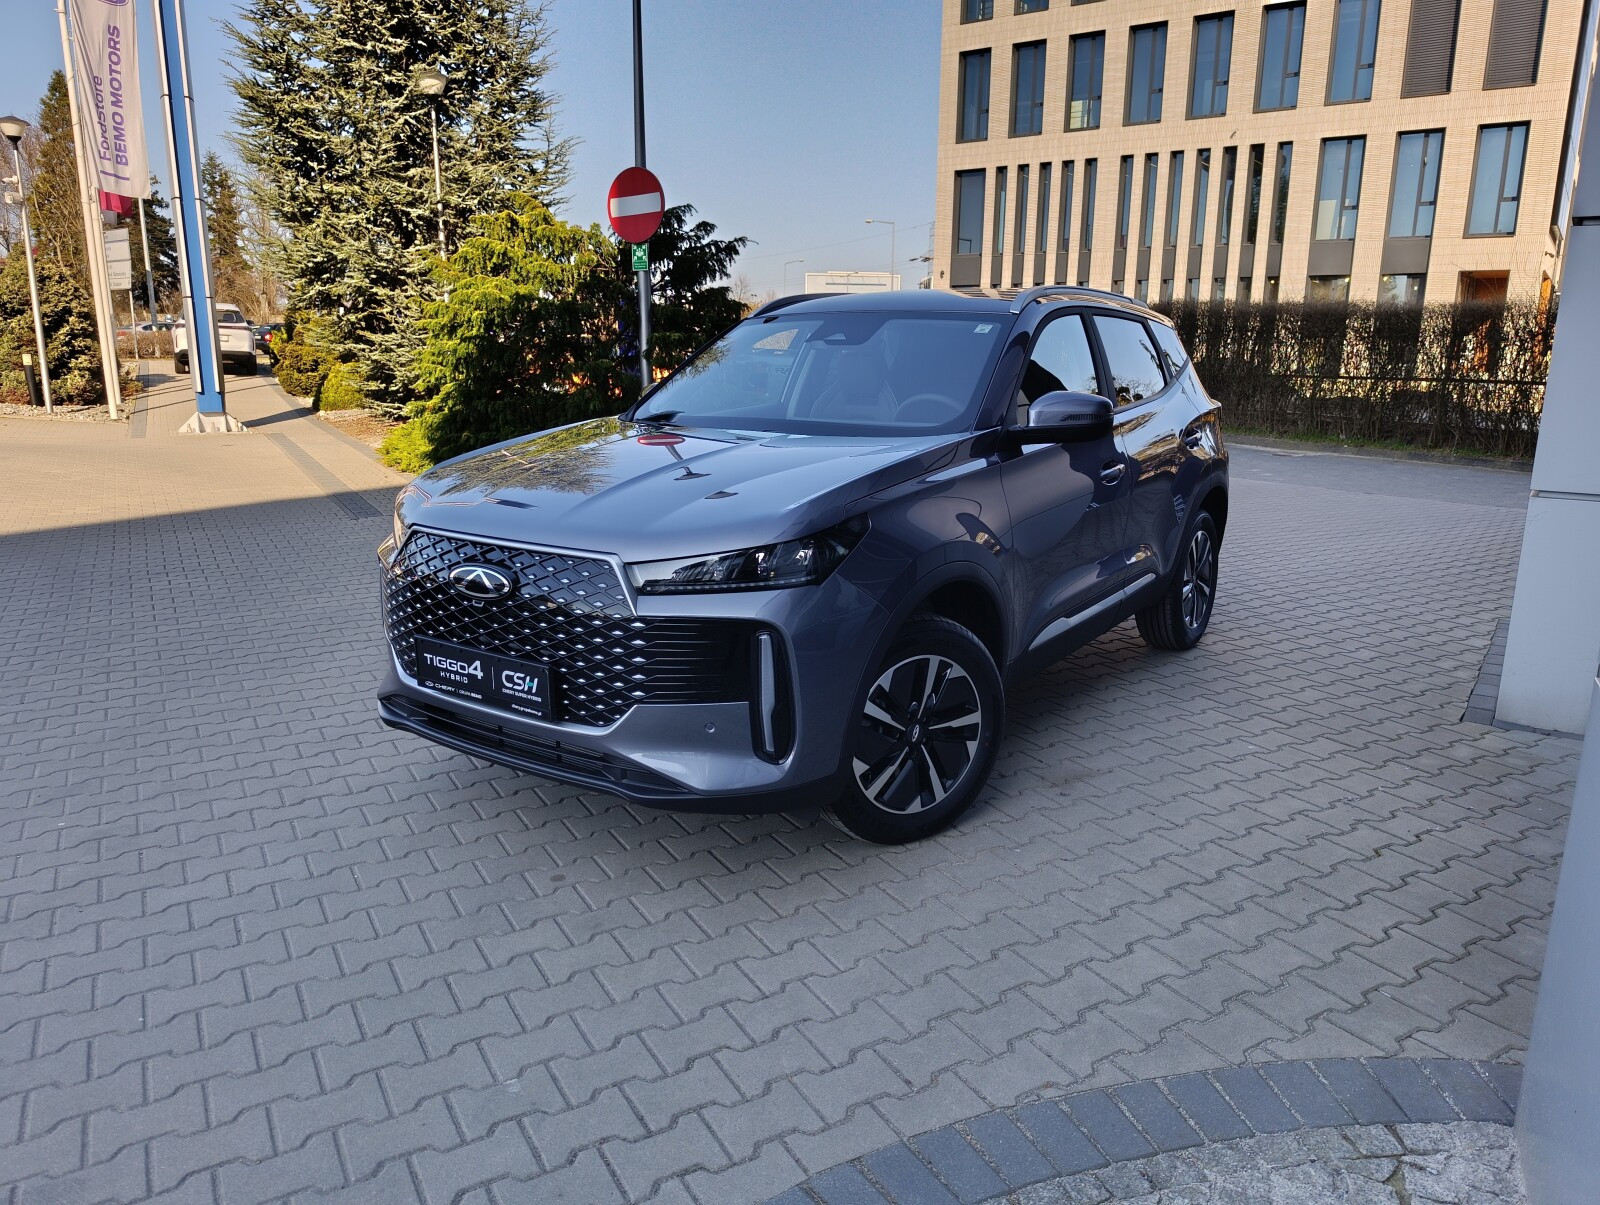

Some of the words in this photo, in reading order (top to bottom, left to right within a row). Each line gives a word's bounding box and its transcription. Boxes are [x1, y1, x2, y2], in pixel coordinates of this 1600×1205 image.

[108, 24, 123, 109] MOTORS
[112, 112, 128, 166] BEMO
[440, 671, 468, 683] HYBRID
[502, 671, 538, 693] CSH
